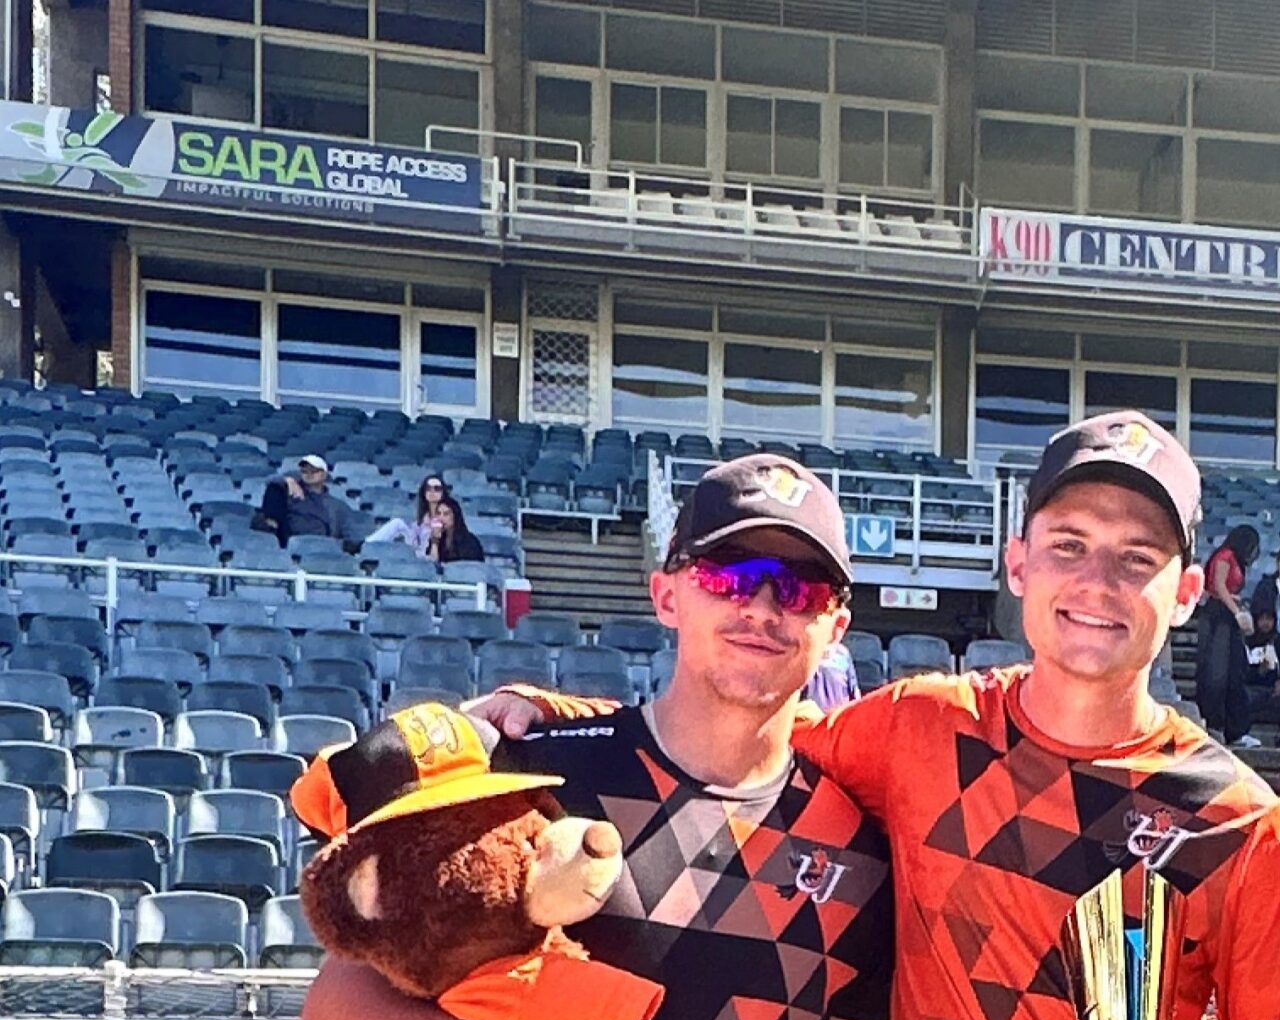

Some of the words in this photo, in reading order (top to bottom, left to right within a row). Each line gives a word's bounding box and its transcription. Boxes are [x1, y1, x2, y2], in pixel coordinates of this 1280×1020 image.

[178, 131, 324, 189] SARA
[327, 148, 383, 172] ROPE
[386, 155, 467, 183] ACCESS
[176, 181, 273, 203] IMPACTFUL
[327, 171, 409, 198] GLOBAL
[988, 214, 1052, 277] K90
